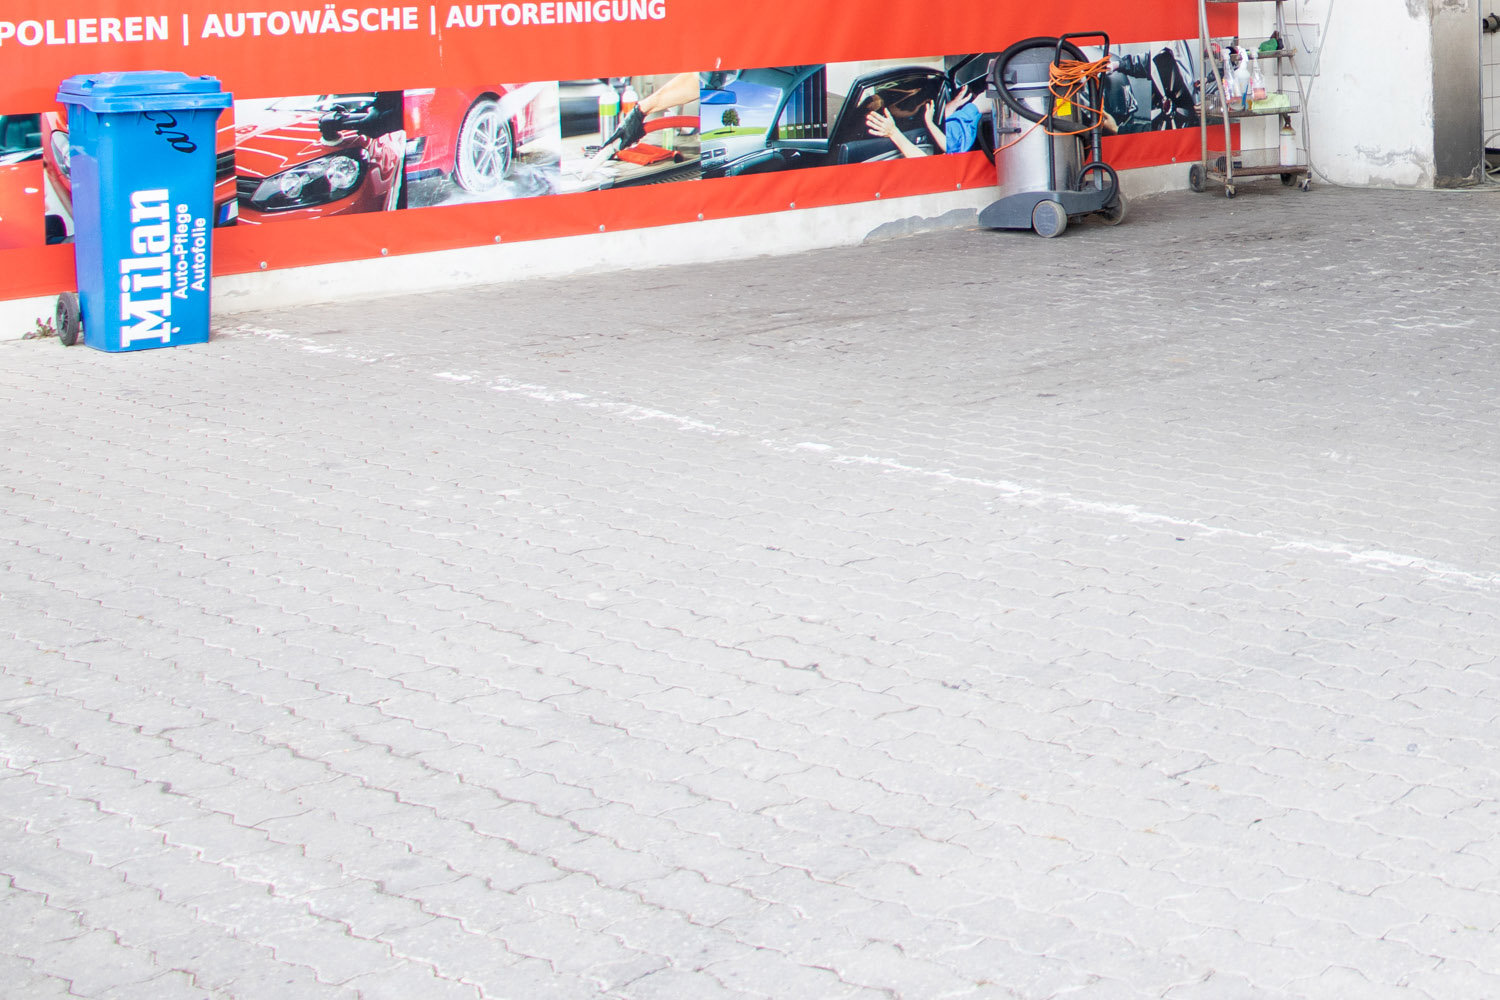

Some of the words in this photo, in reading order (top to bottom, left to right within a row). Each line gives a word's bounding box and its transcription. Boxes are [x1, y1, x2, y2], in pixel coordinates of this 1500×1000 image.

[0, 15, 168, 47] POLIEREN
[202, 4, 419, 38] AUTOWÄSCHE
[120, 188, 172, 349] Milan
[174, 204, 192, 299] Auto-Pflege
[190, 216, 207, 292] Autofolie
